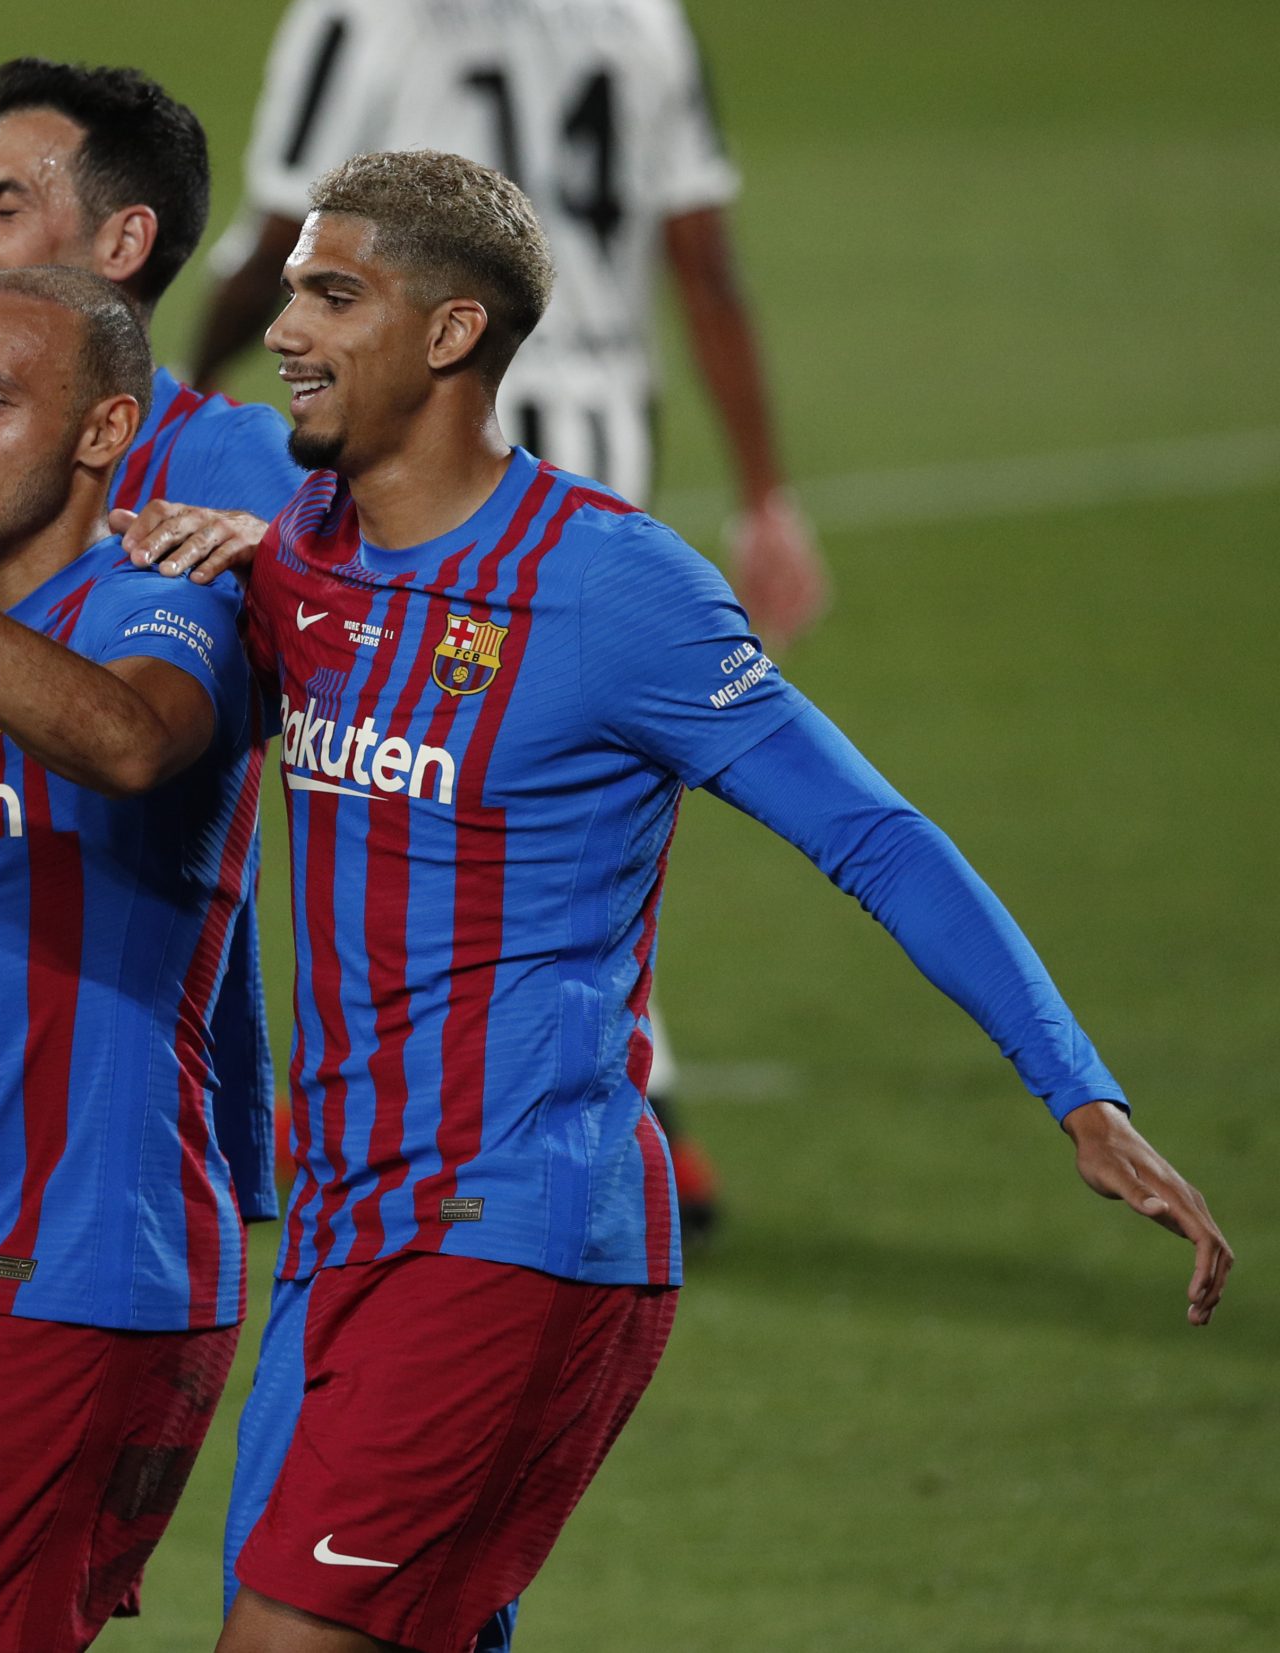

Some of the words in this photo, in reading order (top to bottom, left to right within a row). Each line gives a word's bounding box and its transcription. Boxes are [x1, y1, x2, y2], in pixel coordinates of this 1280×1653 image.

[154, 609, 214, 650] CULERS
[343, 620, 360, 632] MORE
[361, 623, 383, 637] THAN
[349, 632, 380, 647] PLAYERS
